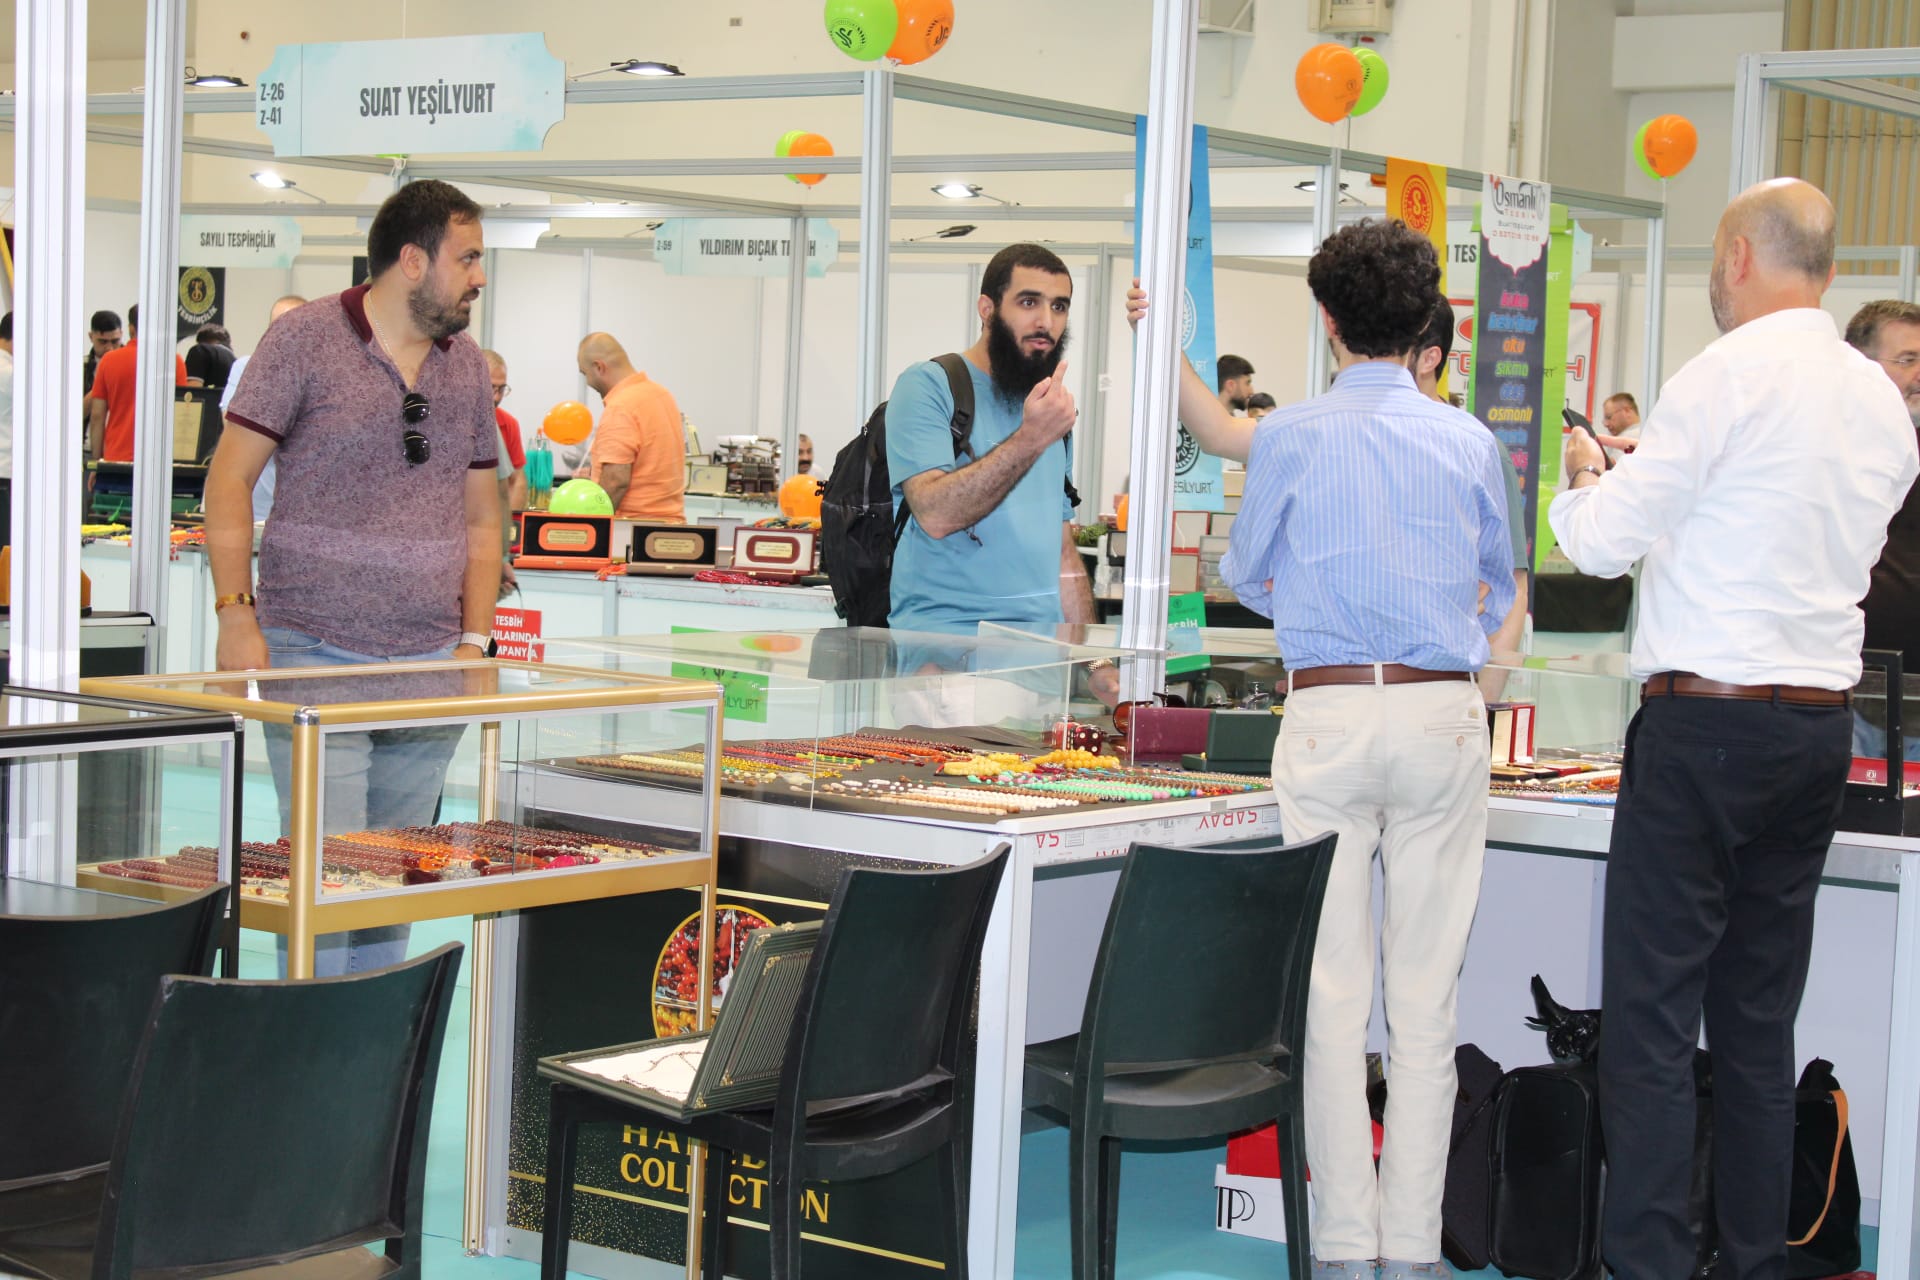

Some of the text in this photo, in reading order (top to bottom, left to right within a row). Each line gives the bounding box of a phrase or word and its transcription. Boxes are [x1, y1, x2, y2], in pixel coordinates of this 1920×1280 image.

[260, 83, 284, 101] Z-26
[360, 78, 495, 124] SUAT YEŞİLYURT
[260, 107, 282, 125] Z-41
[200, 230, 276, 252] SAYILI TESPİHÇİLİK
[700, 239, 744, 255] YILDIRIM
[748, 239, 778, 261] BIÇAK
[1454, 244, 1477, 263] TES
[495, 614, 523, 628] TESBİH
[491, 629, 539, 643] TULARINDA
[620, 1152, 829, 1224] COLCTN
